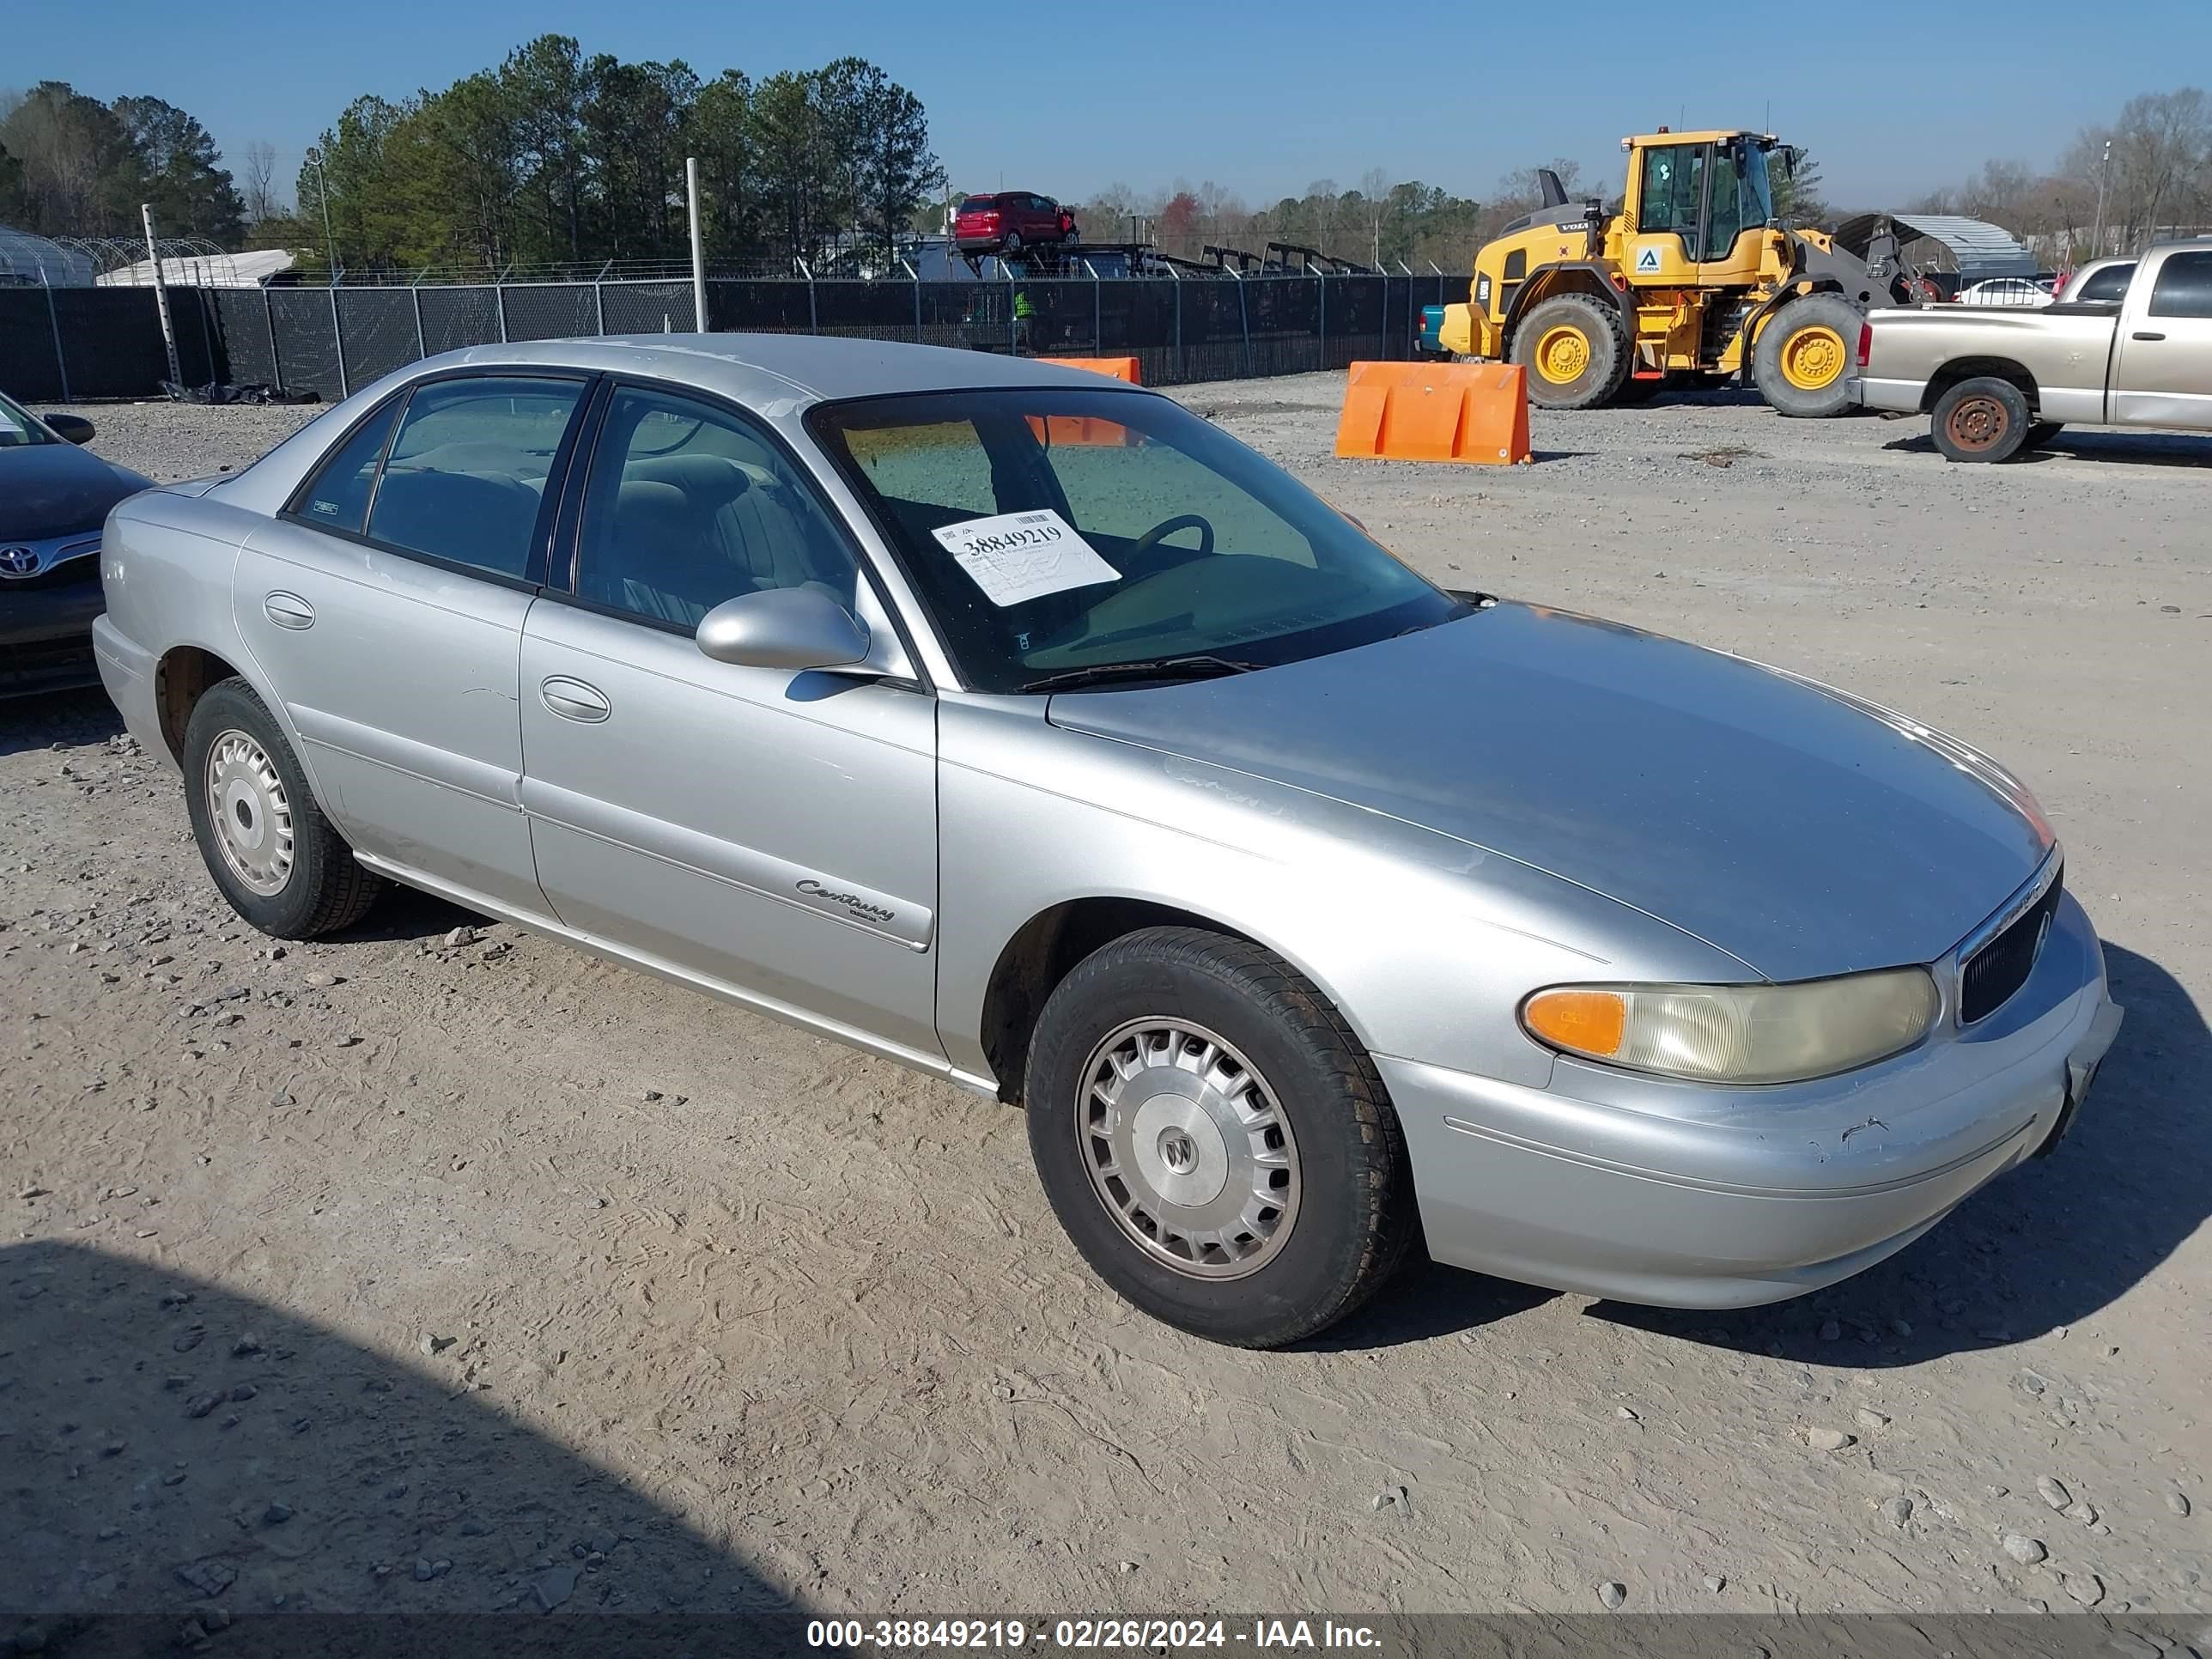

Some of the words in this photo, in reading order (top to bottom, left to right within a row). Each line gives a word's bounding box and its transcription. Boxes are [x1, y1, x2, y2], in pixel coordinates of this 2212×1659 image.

[1562, 222, 1589, 231] VOLV
[963, 526, 1062, 557] 38849219
[795, 879, 896, 922] Century
